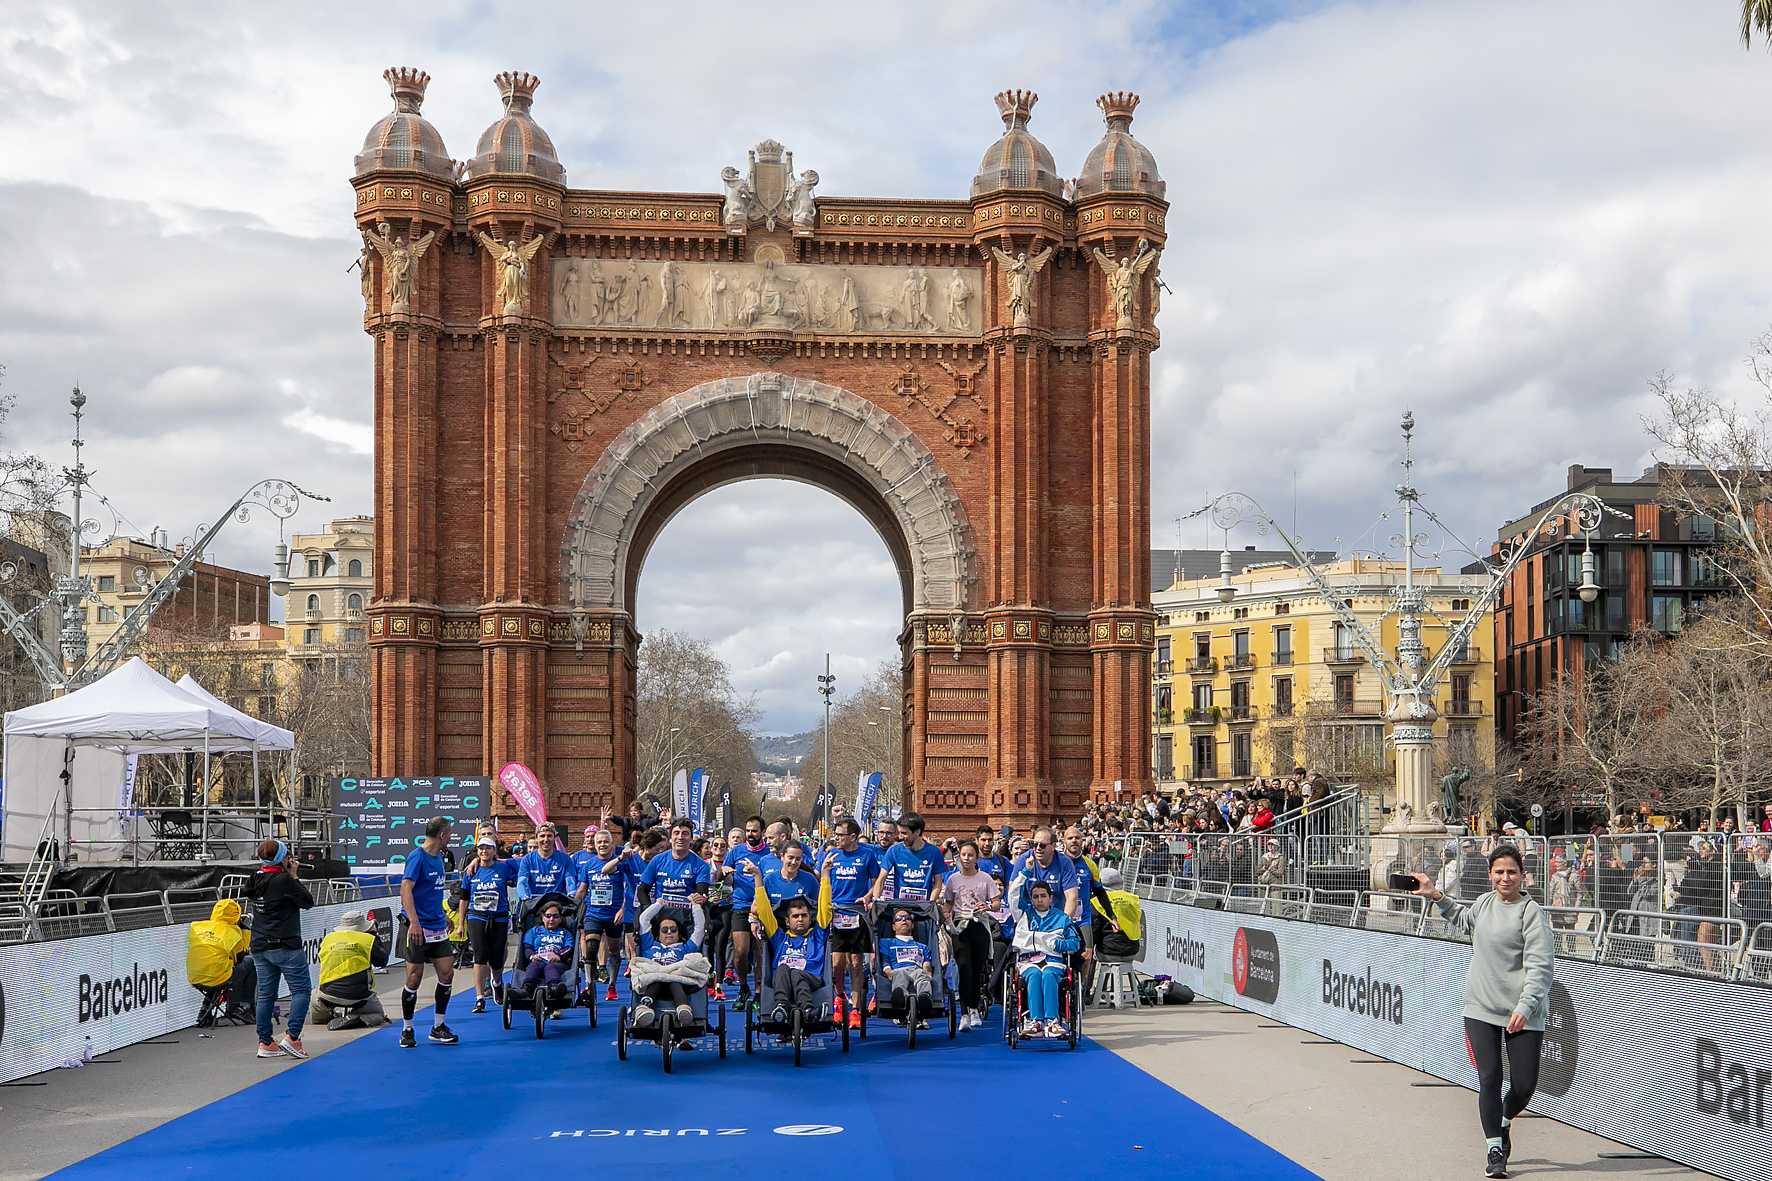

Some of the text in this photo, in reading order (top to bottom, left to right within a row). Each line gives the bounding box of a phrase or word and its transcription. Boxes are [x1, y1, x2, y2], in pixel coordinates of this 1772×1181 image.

[691, 782, 699, 816] ZURICH
[1166, 927, 1205, 970] Barcelona
[1249, 961, 1274, 983] Barcelona
[79, 962, 168, 1023] Barcelona
[1323, 959, 1402, 1025] Barcelona
[550, 1127, 748, 1138] ZURICH
